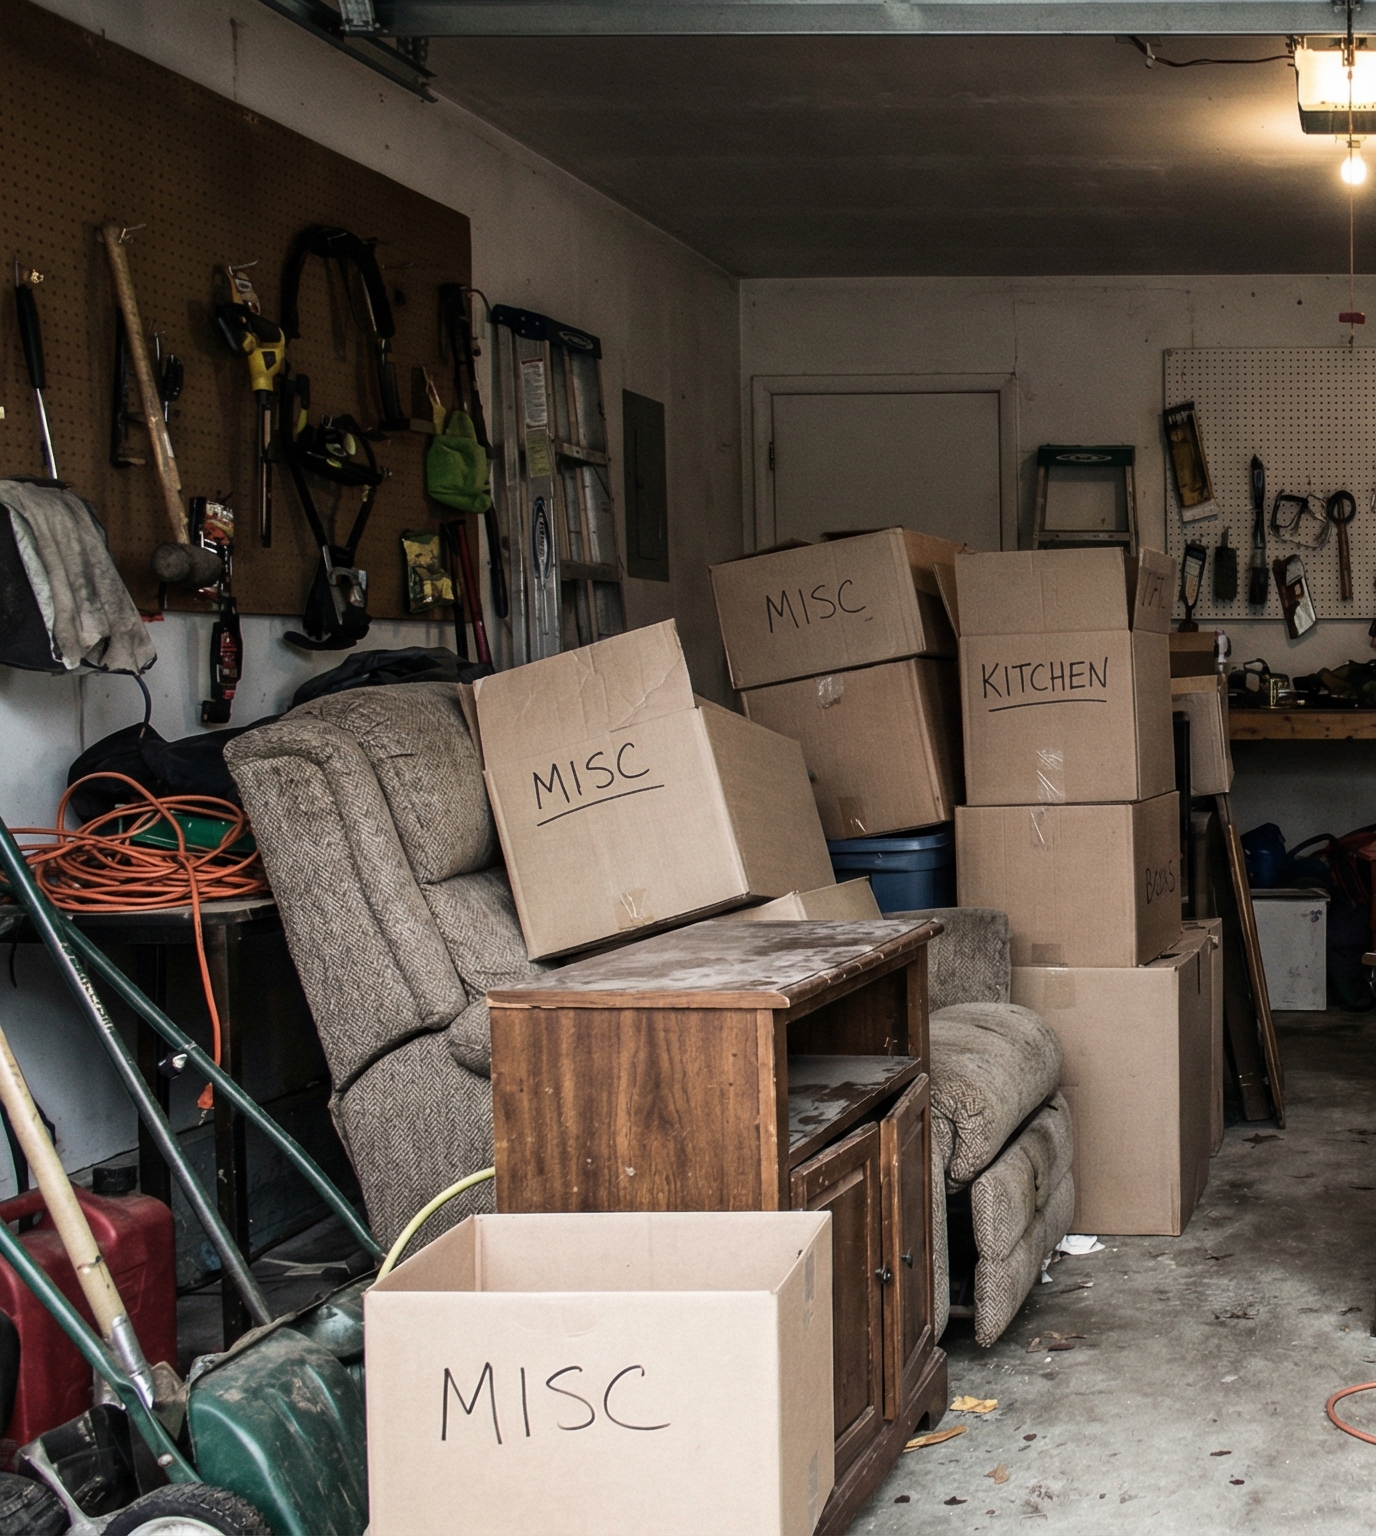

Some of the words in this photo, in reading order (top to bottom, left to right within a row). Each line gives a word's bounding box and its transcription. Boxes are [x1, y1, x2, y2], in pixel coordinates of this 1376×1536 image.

[981, 656, 1109, 699] KITCHEN
[532, 742, 651, 810] MISC
[440, 1361, 672, 1446] MISC
